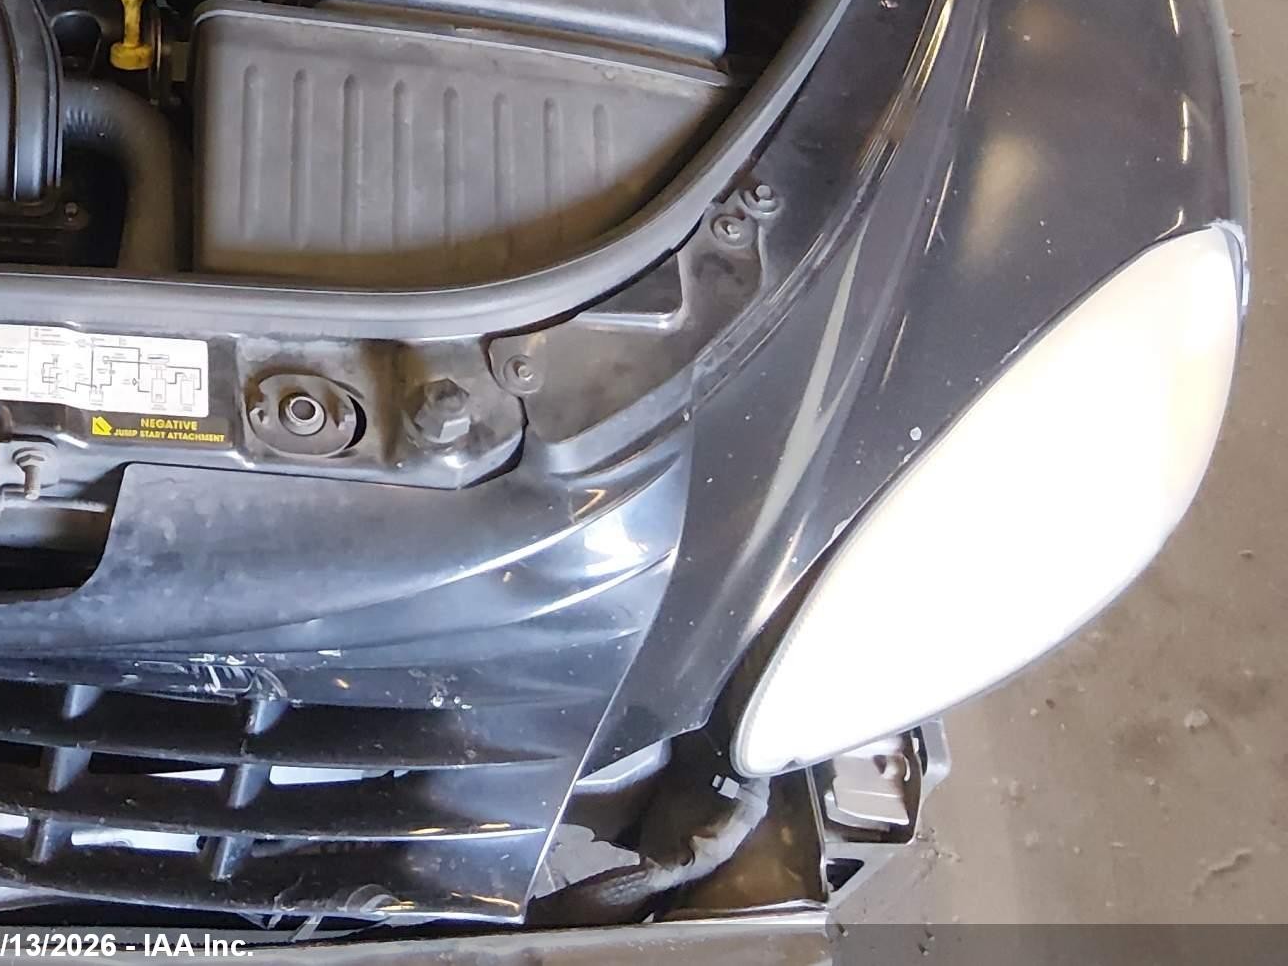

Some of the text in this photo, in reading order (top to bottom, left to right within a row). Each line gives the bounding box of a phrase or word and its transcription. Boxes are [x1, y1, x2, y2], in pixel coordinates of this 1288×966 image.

[141, 418, 198, 430] NEGATIVE
[114, 429, 225, 442] JUMP START ATTACHMENT
